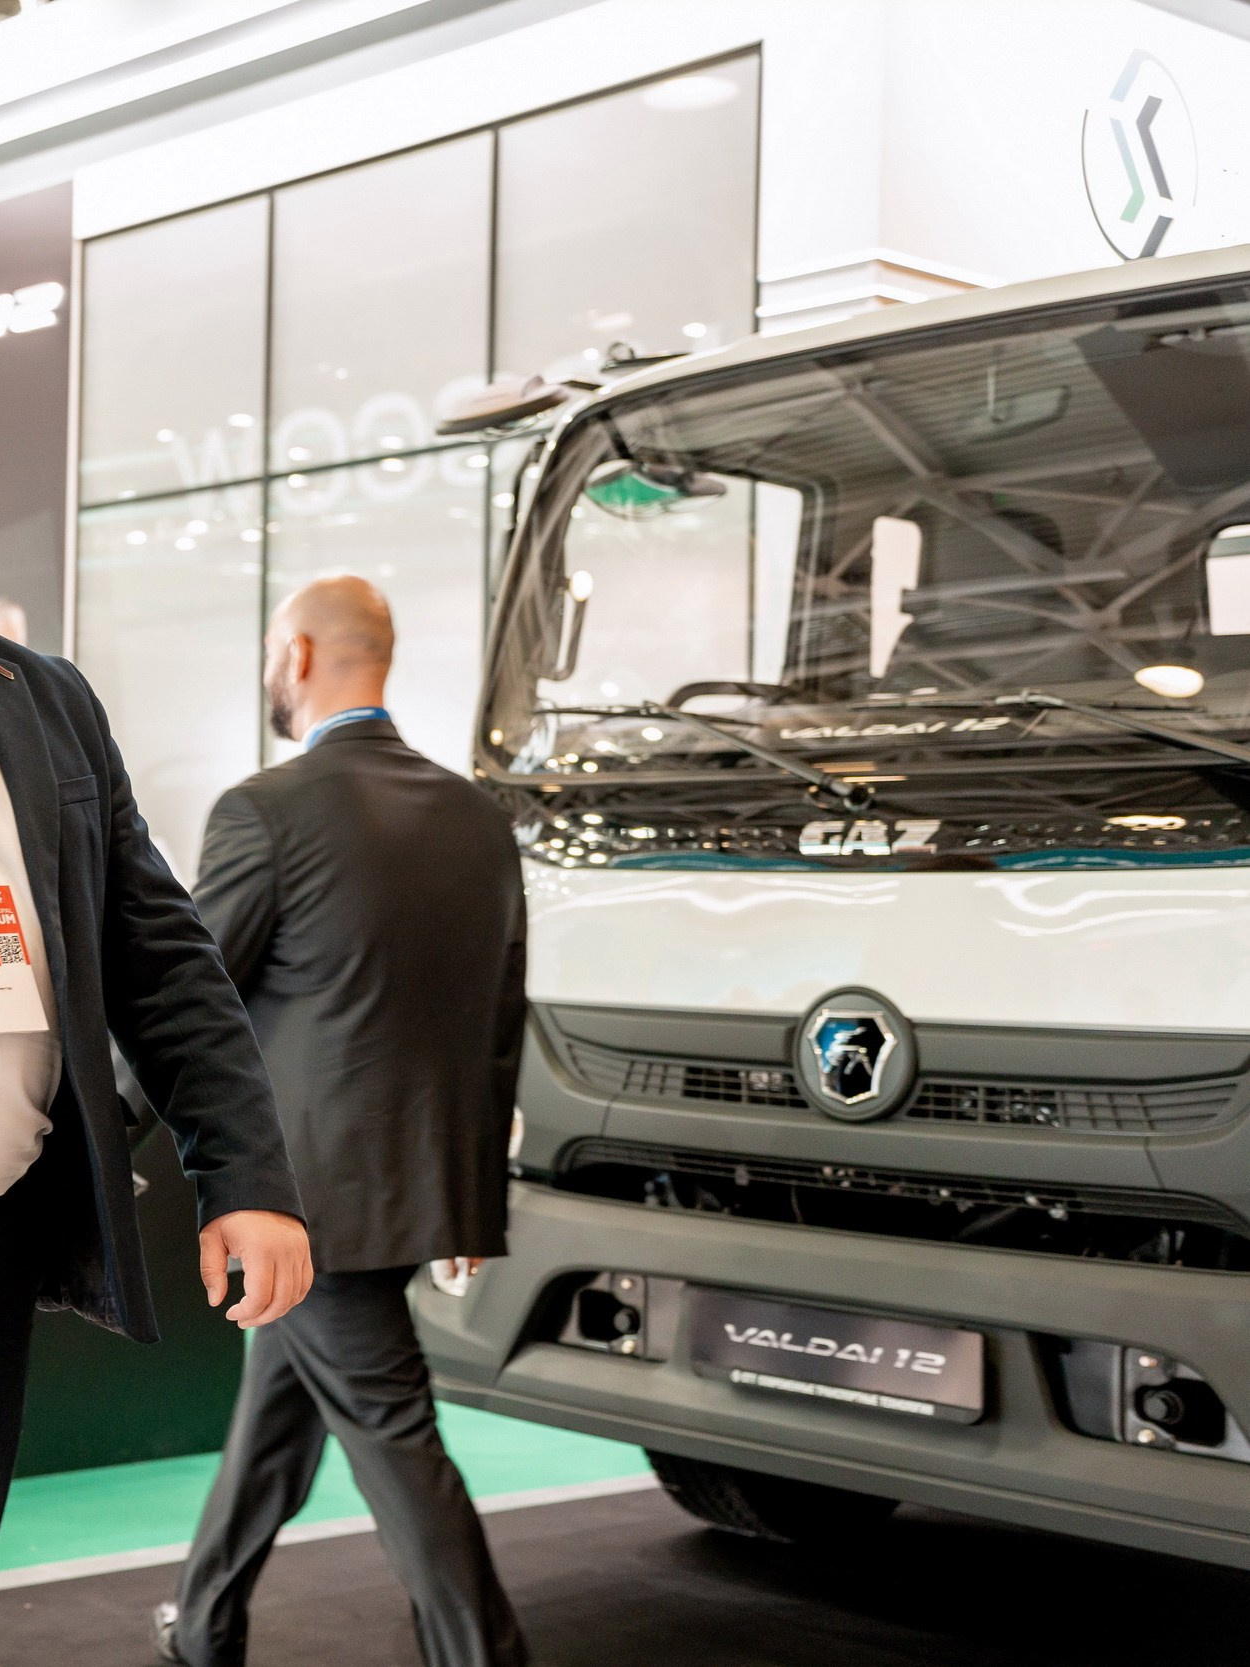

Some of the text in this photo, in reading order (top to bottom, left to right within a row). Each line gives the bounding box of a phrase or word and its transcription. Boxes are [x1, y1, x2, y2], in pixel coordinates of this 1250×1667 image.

[780, 716, 1011, 739] VALDAI 12
[799, 819, 942, 856] GAZ
[724, 1323, 946, 1375] VALDAI 12
